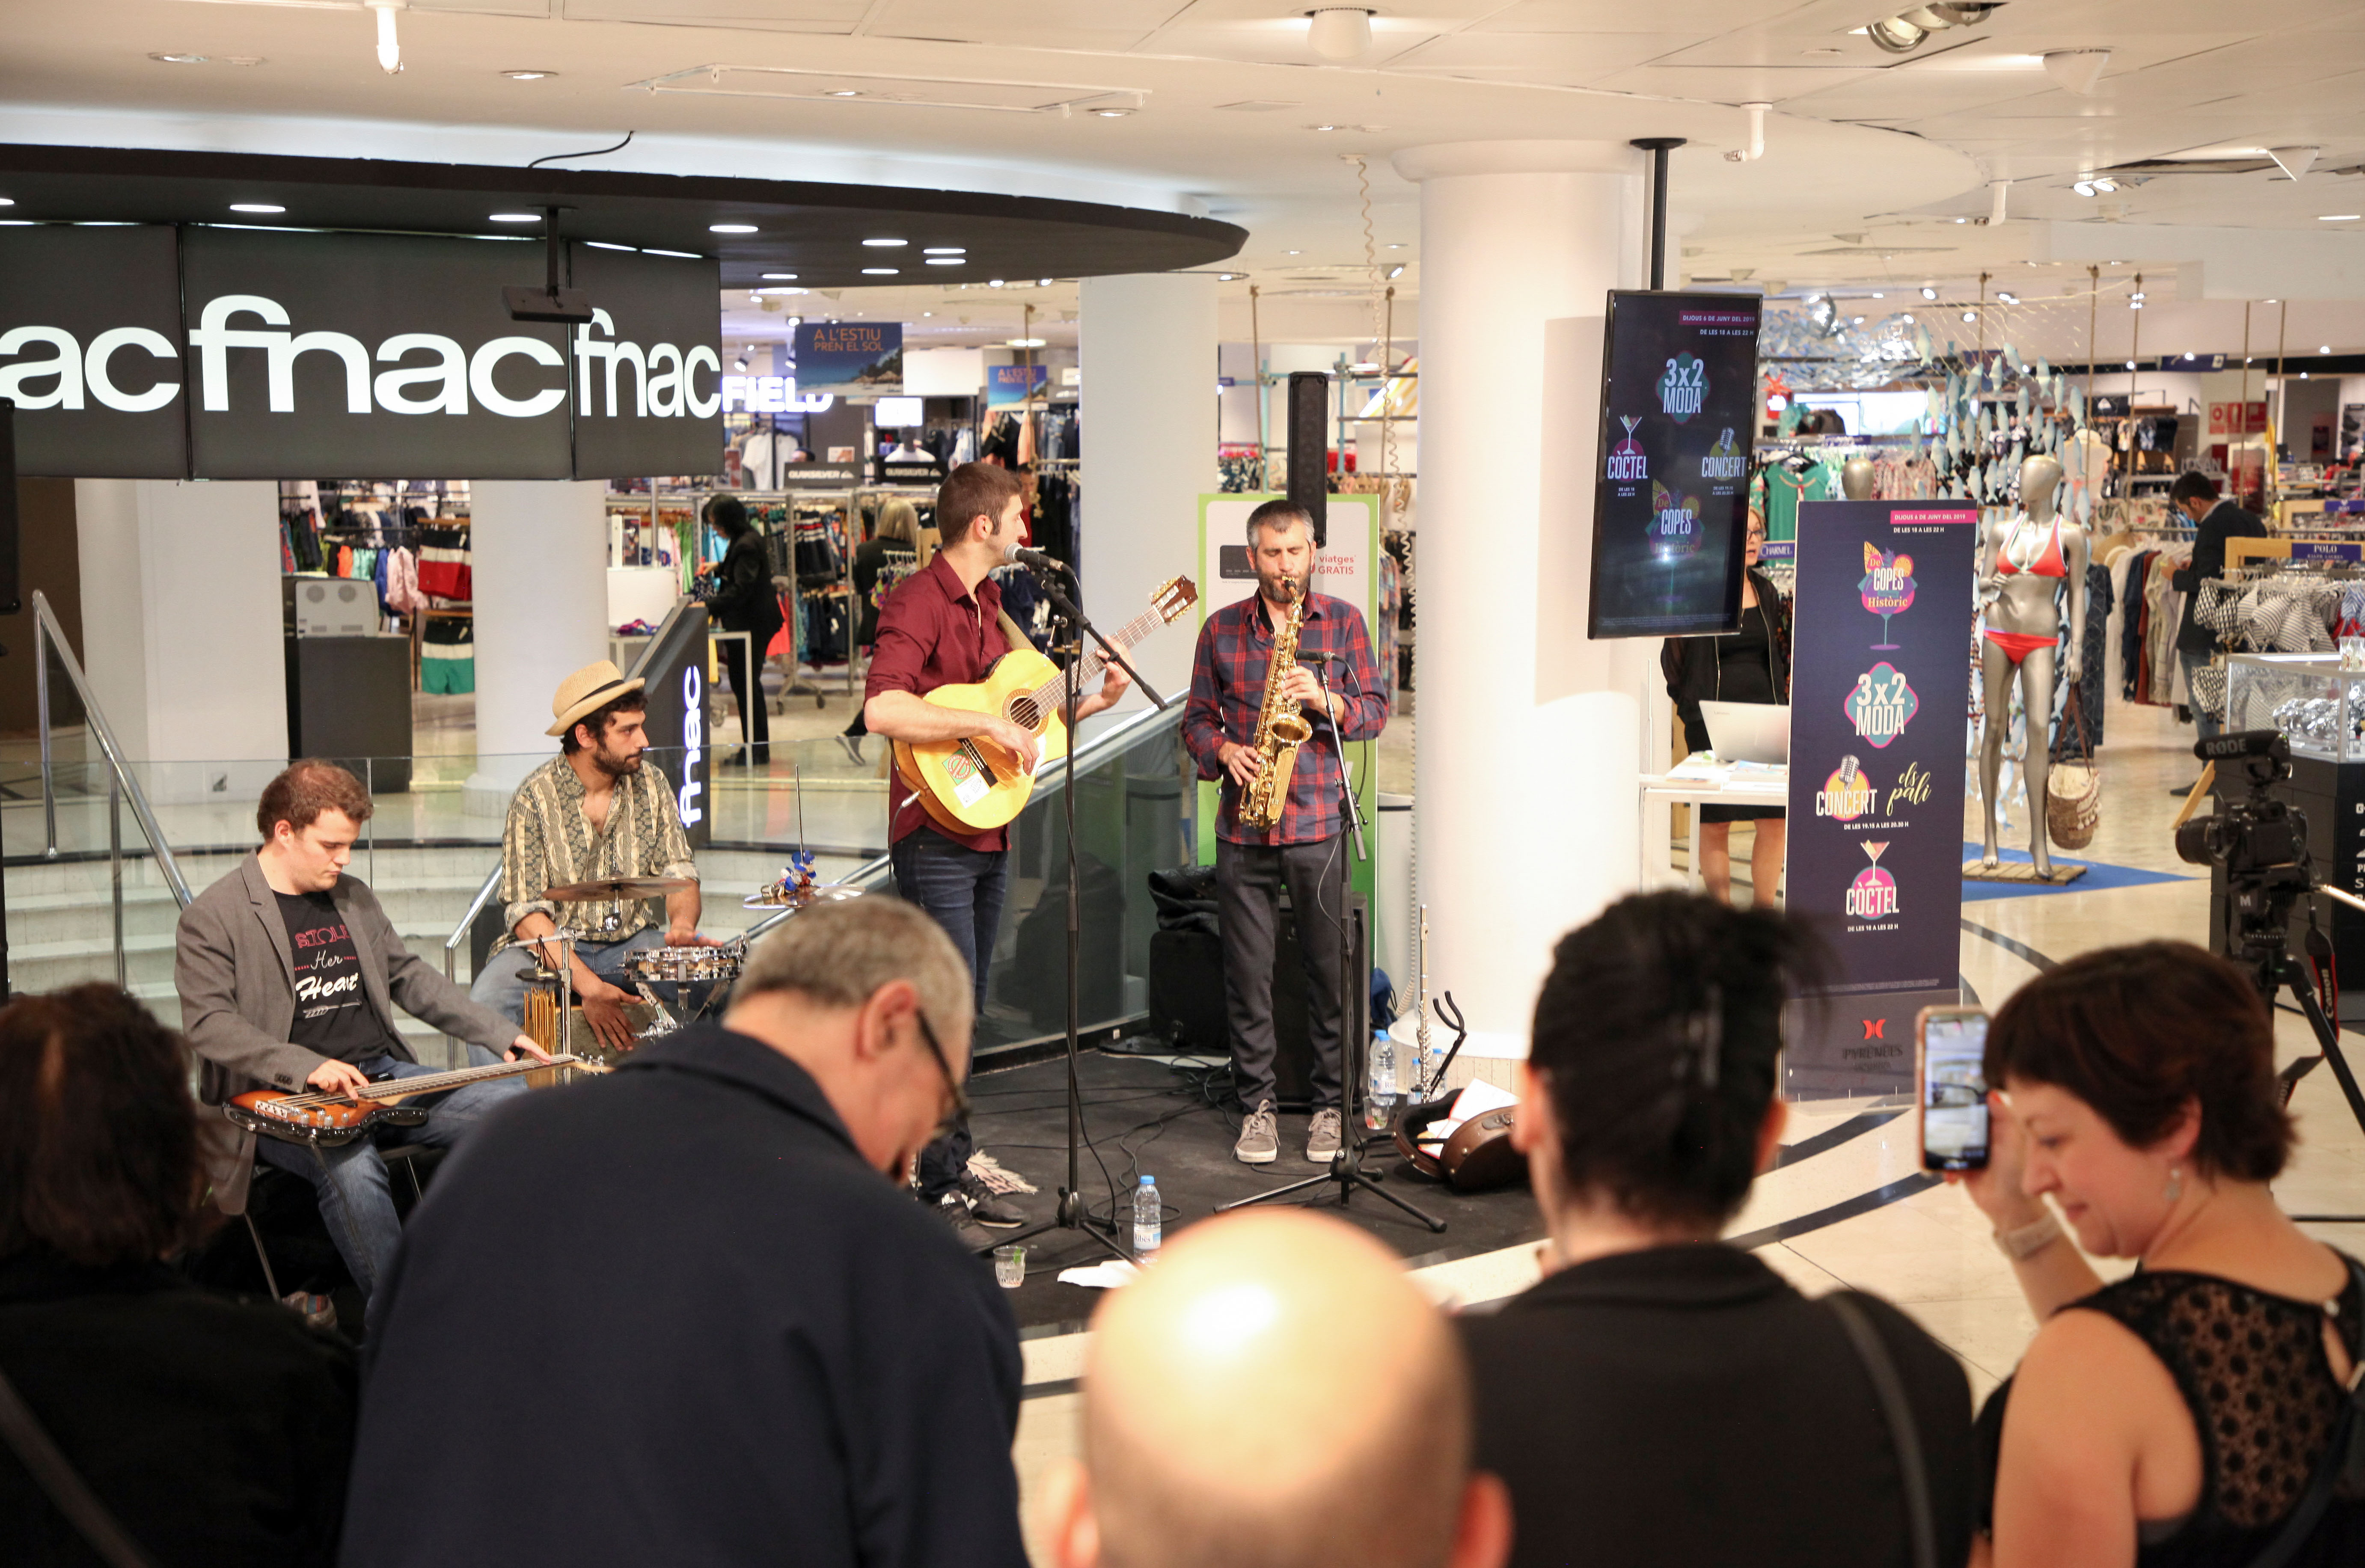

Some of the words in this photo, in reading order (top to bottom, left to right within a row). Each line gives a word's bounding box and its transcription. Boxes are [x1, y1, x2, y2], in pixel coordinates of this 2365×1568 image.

[814, 328, 825, 341] A
[829, 328, 881, 341] L'ESTIU
[814, 342, 844, 351] PREN
[847, 342, 859, 351] EL
[862, 342, 884, 351] SOL
[189, 294, 566, 417] fnac
[573, 307, 722, 419] fnac
[1007, 368, 1037, 377] L'ESTU
[1663, 387, 1702, 413] MODA
[788, 470, 841, 479] QUIKSILVER
[1607, 450, 1648, 479] CÒCTEL
[1702, 457, 1747, 477] CONCERT
[1658, 499, 1669, 507] De
[1661, 509, 1692, 535] COPES
[2314, 545, 2337, 553] POLO
[1319, 566, 1354, 574] GRATIS
[1873, 567, 1904, 591] COPES
[1868, 596, 1907, 607] Històric
[1856, 704, 1905, 736] MODA
[680, 665, 702, 828] fnac
[1898, 761, 1919, 787] els
[1816, 789, 1878, 816] CONCERT
[1886, 772, 1931, 817] pali
[1846, 882, 1899, 915] CÒCTEL
[310, 949, 343, 970] Her
[295, 972, 359, 1001] Heart
